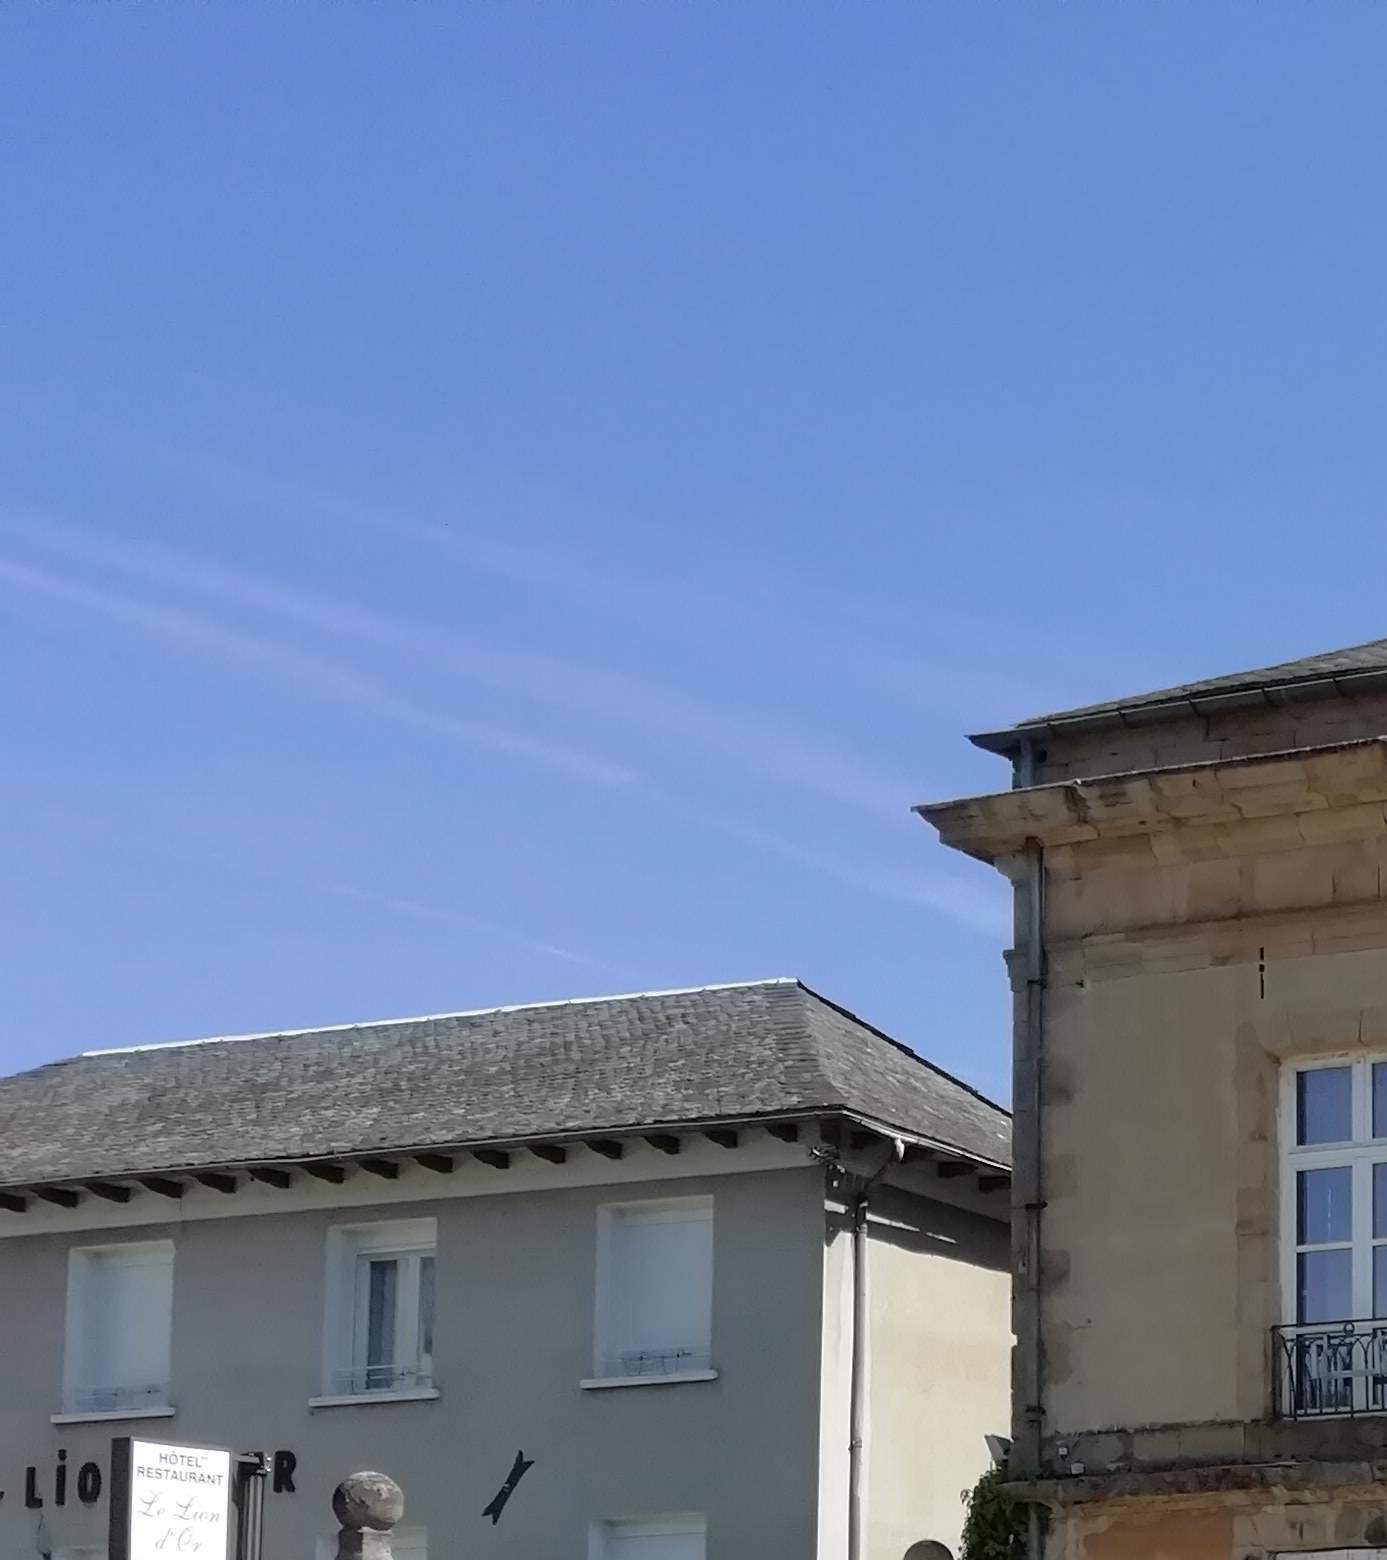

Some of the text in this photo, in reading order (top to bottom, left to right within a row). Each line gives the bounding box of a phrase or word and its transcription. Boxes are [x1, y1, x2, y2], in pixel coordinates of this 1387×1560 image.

[136, 1466, 224, 1486] RESTAURANT
[136, 1489, 221, 1523] Le Lion
[155, 1525, 203, 1553] d'Or
